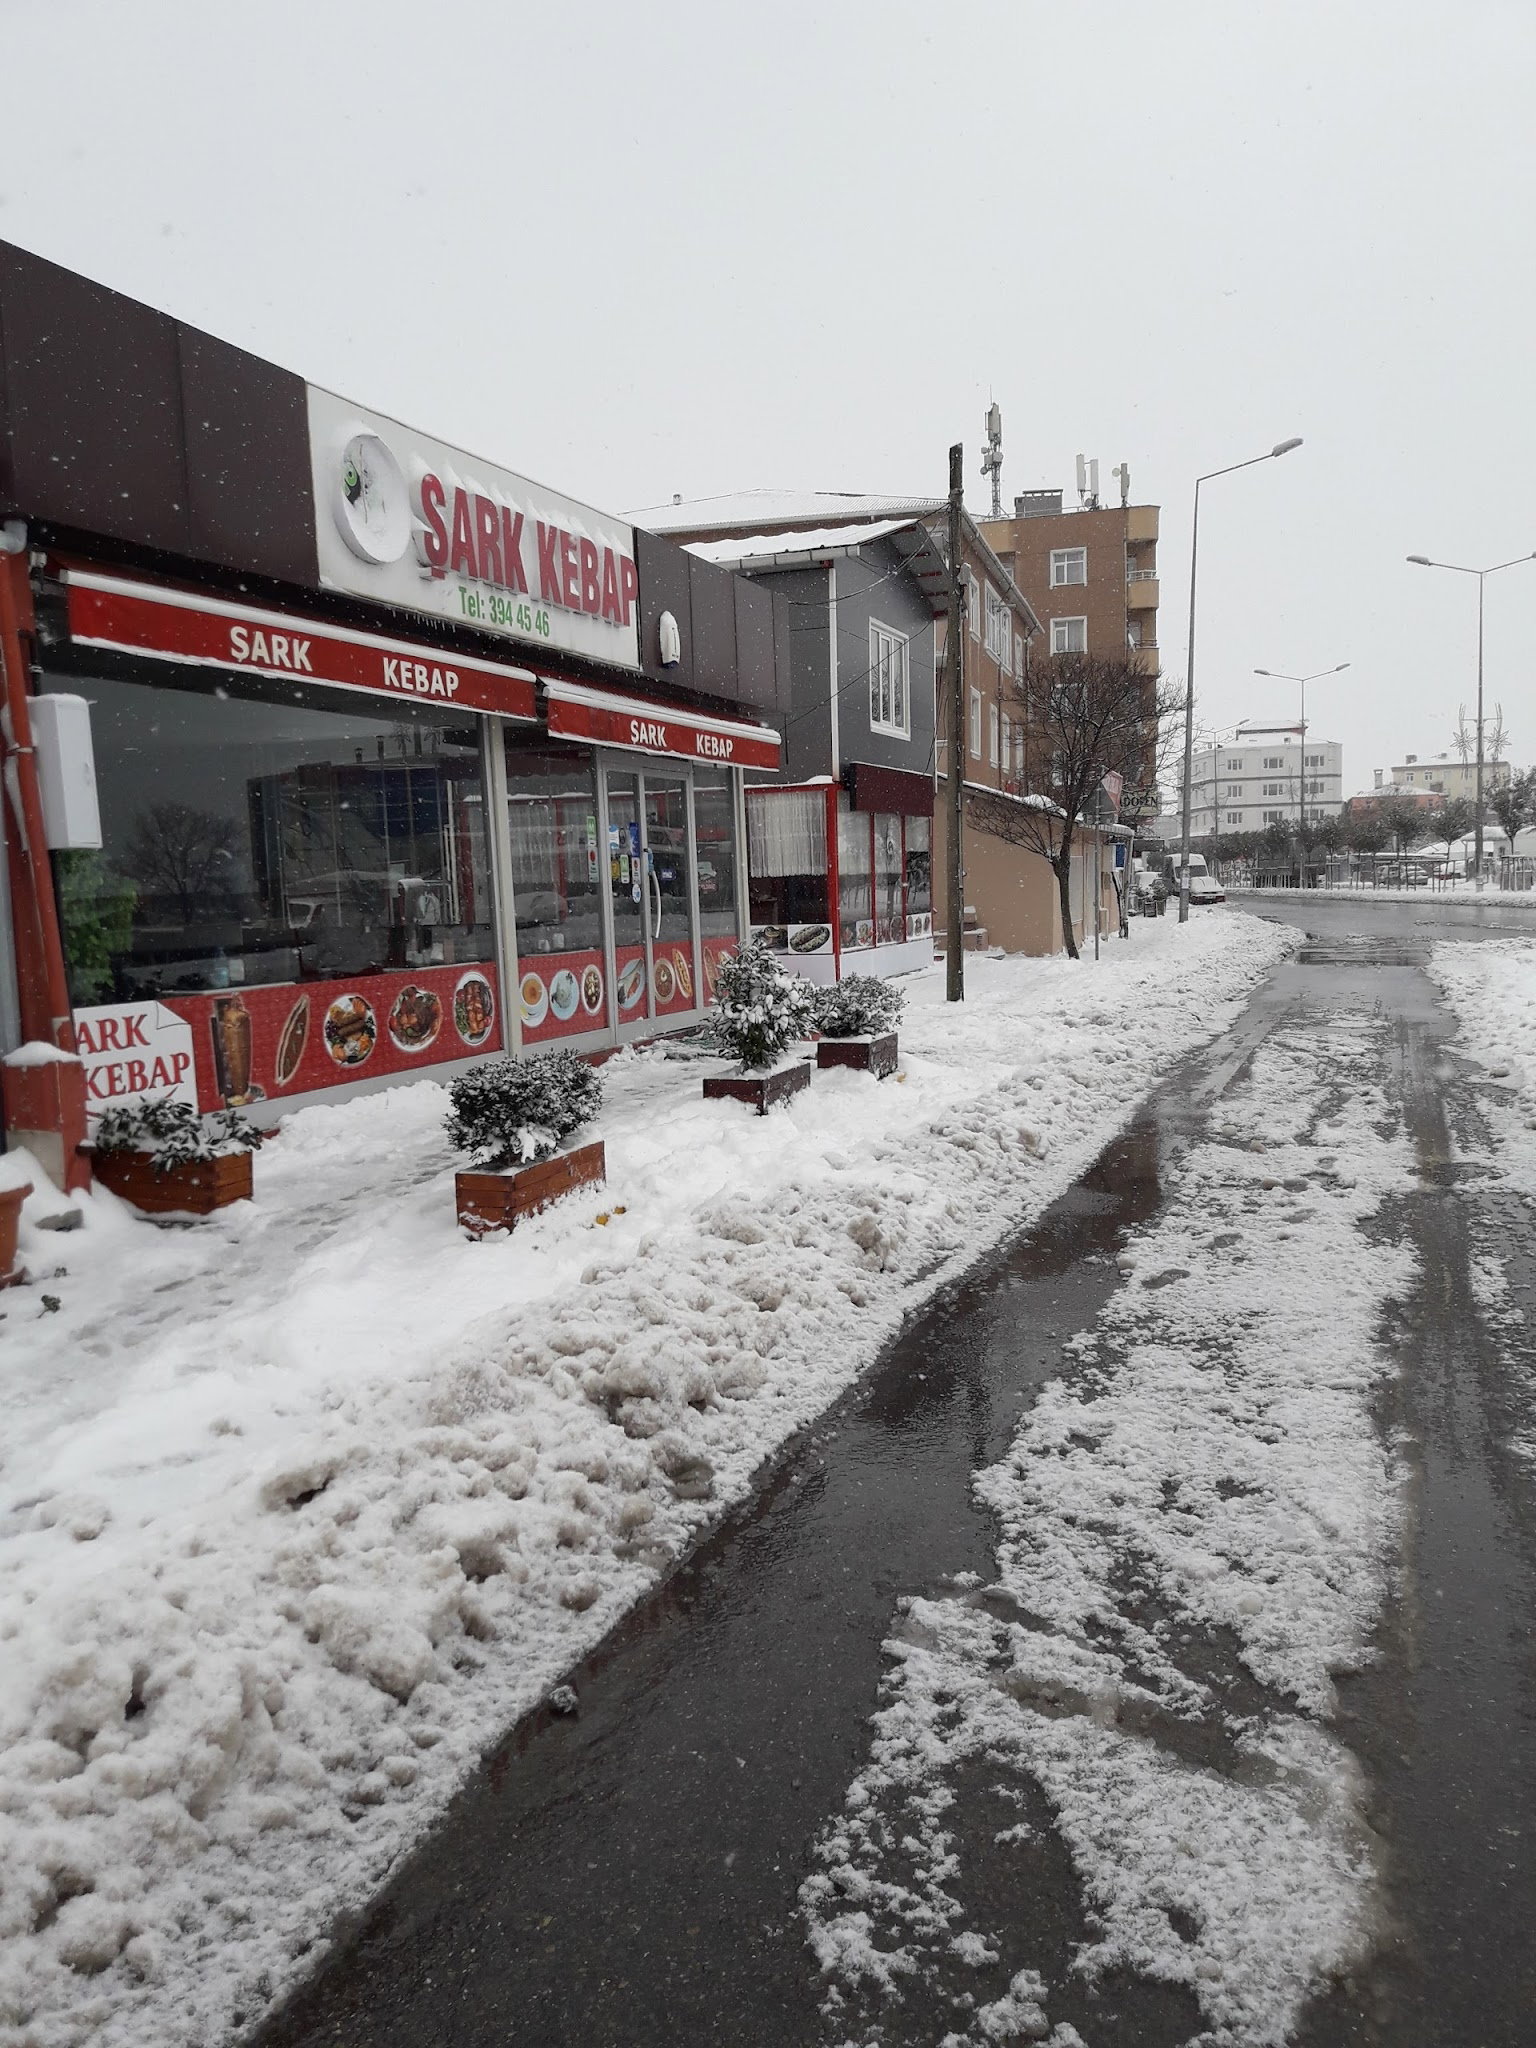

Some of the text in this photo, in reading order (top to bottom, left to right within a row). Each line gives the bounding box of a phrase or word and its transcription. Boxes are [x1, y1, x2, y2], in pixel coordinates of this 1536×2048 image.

[421, 473, 638, 626] ŞARK KEBAP
[459, 586, 550, 637] Tel: 394 45 46
[229, 626, 459, 697] ŞARK KEBAP
[630, 720, 733, 758] ŞARK KEBAP
[75, 1014, 151, 1054] ARK
[86, 1052, 191, 1100] KEBAP
